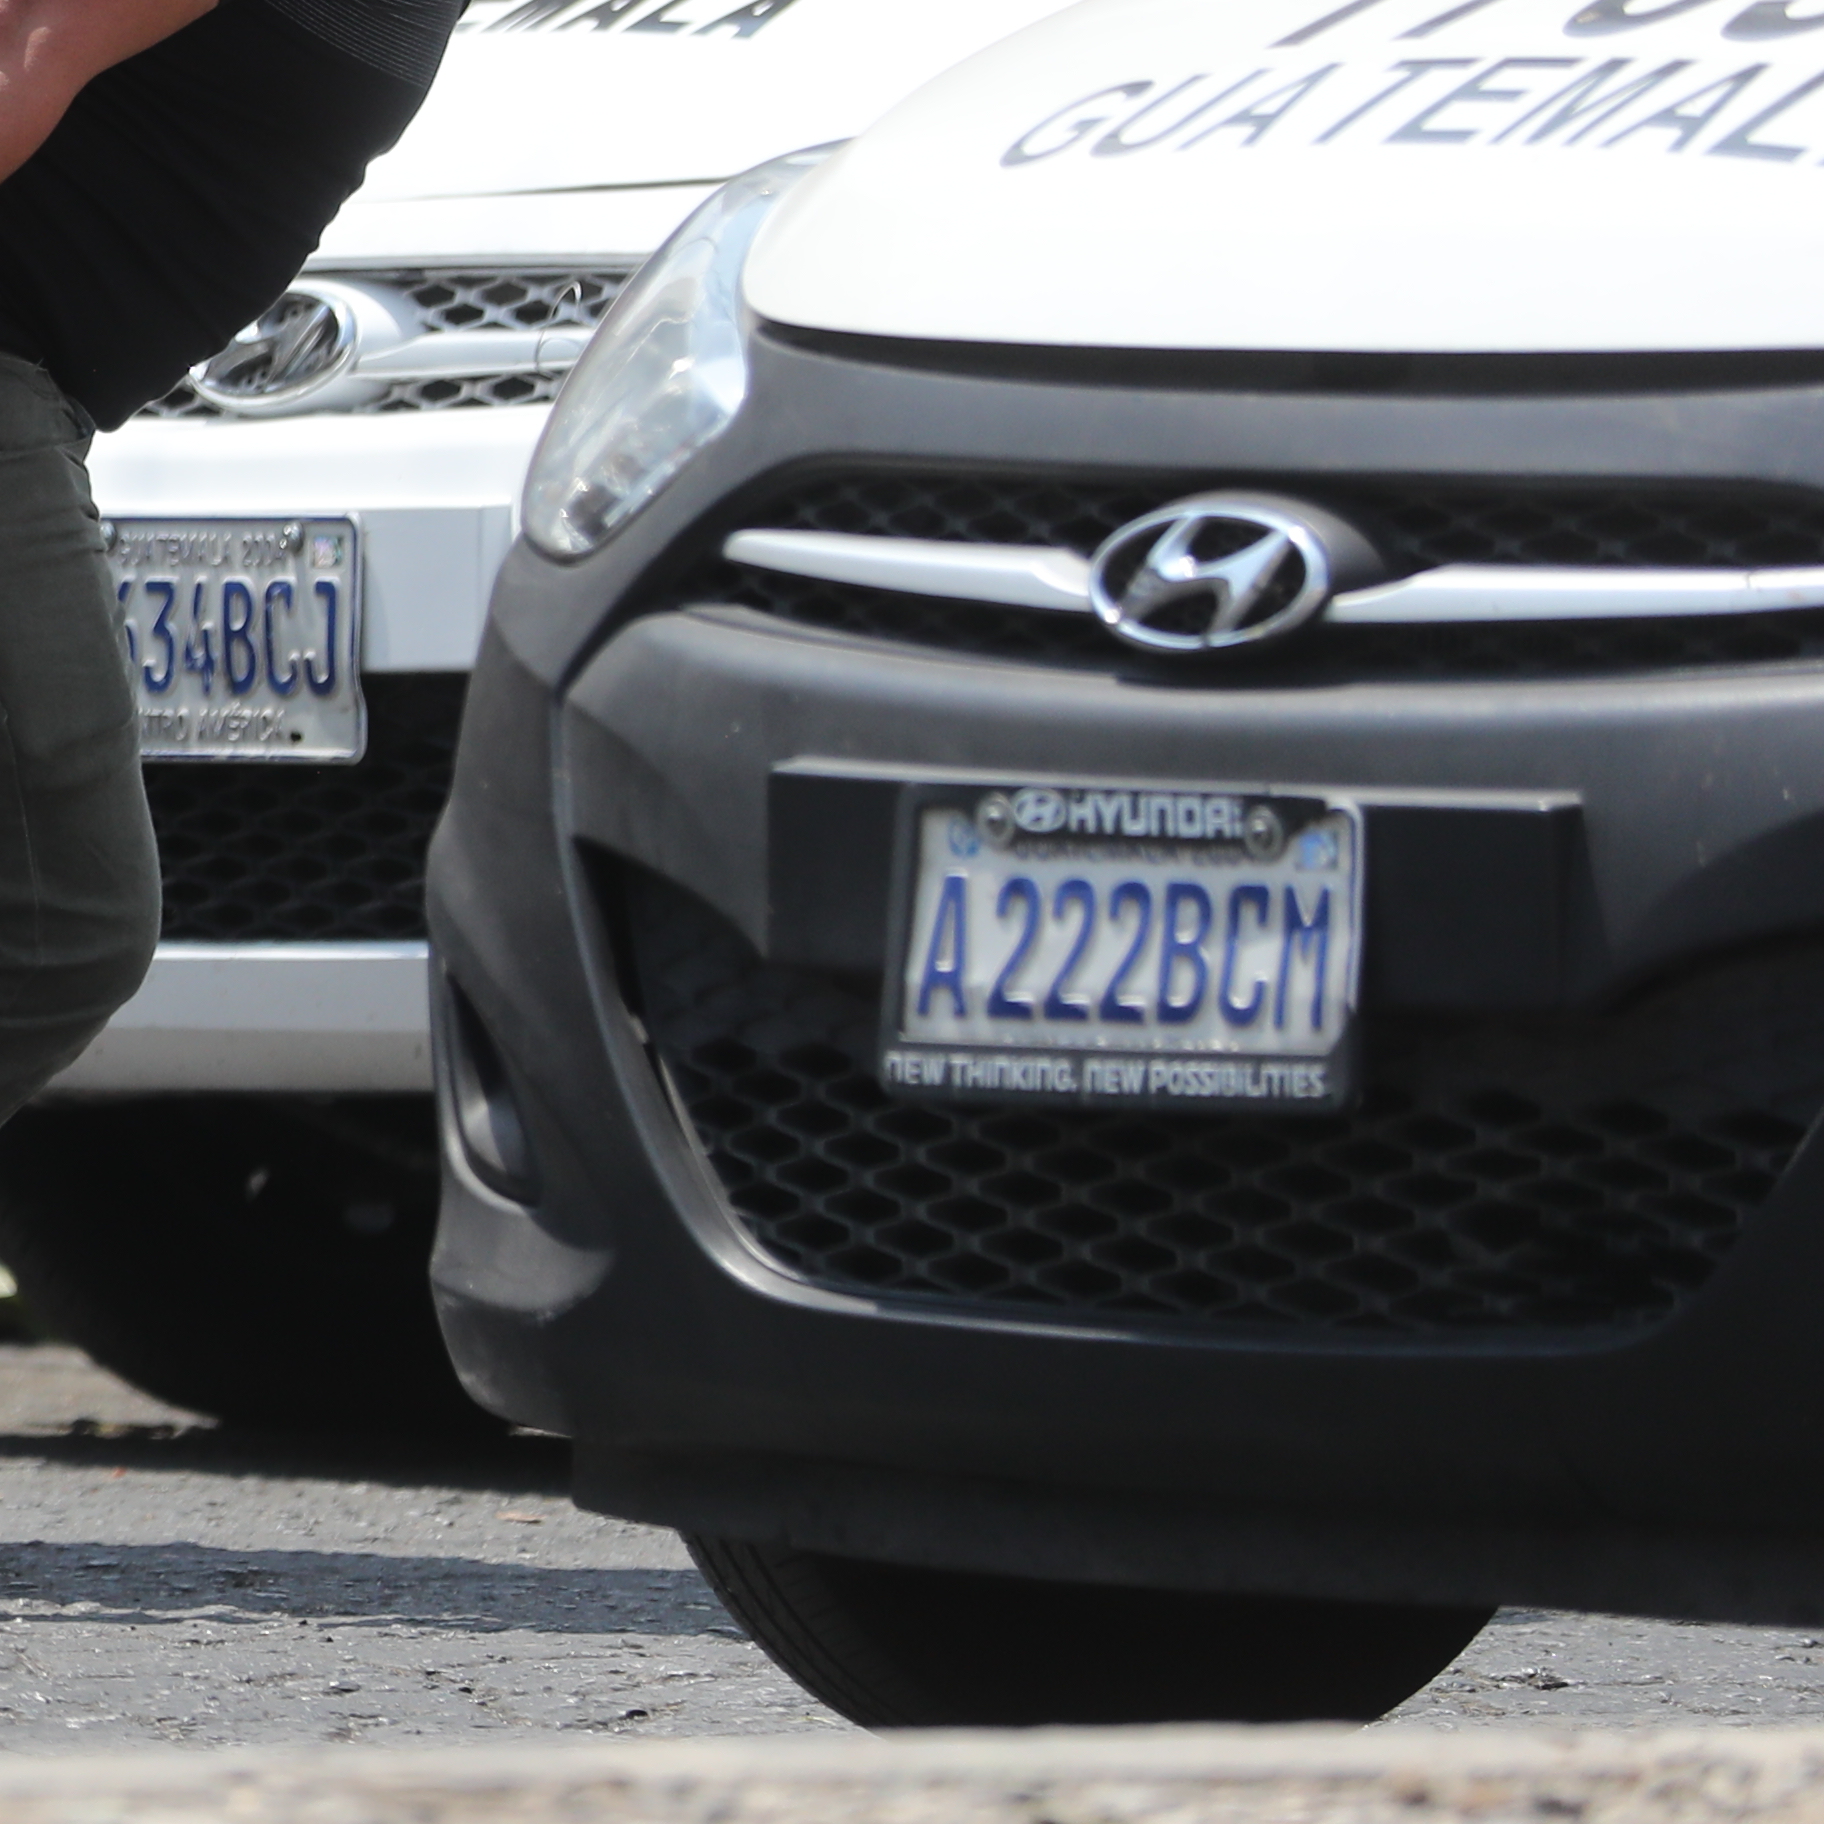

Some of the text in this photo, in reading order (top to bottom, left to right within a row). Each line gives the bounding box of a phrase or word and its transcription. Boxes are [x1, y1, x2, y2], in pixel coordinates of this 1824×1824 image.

[1000, 57, 1824, 167] GUATEMAL
[884, 1050, 949, 1085] NEW
[1083, 1058, 1146, 1096] NEW
